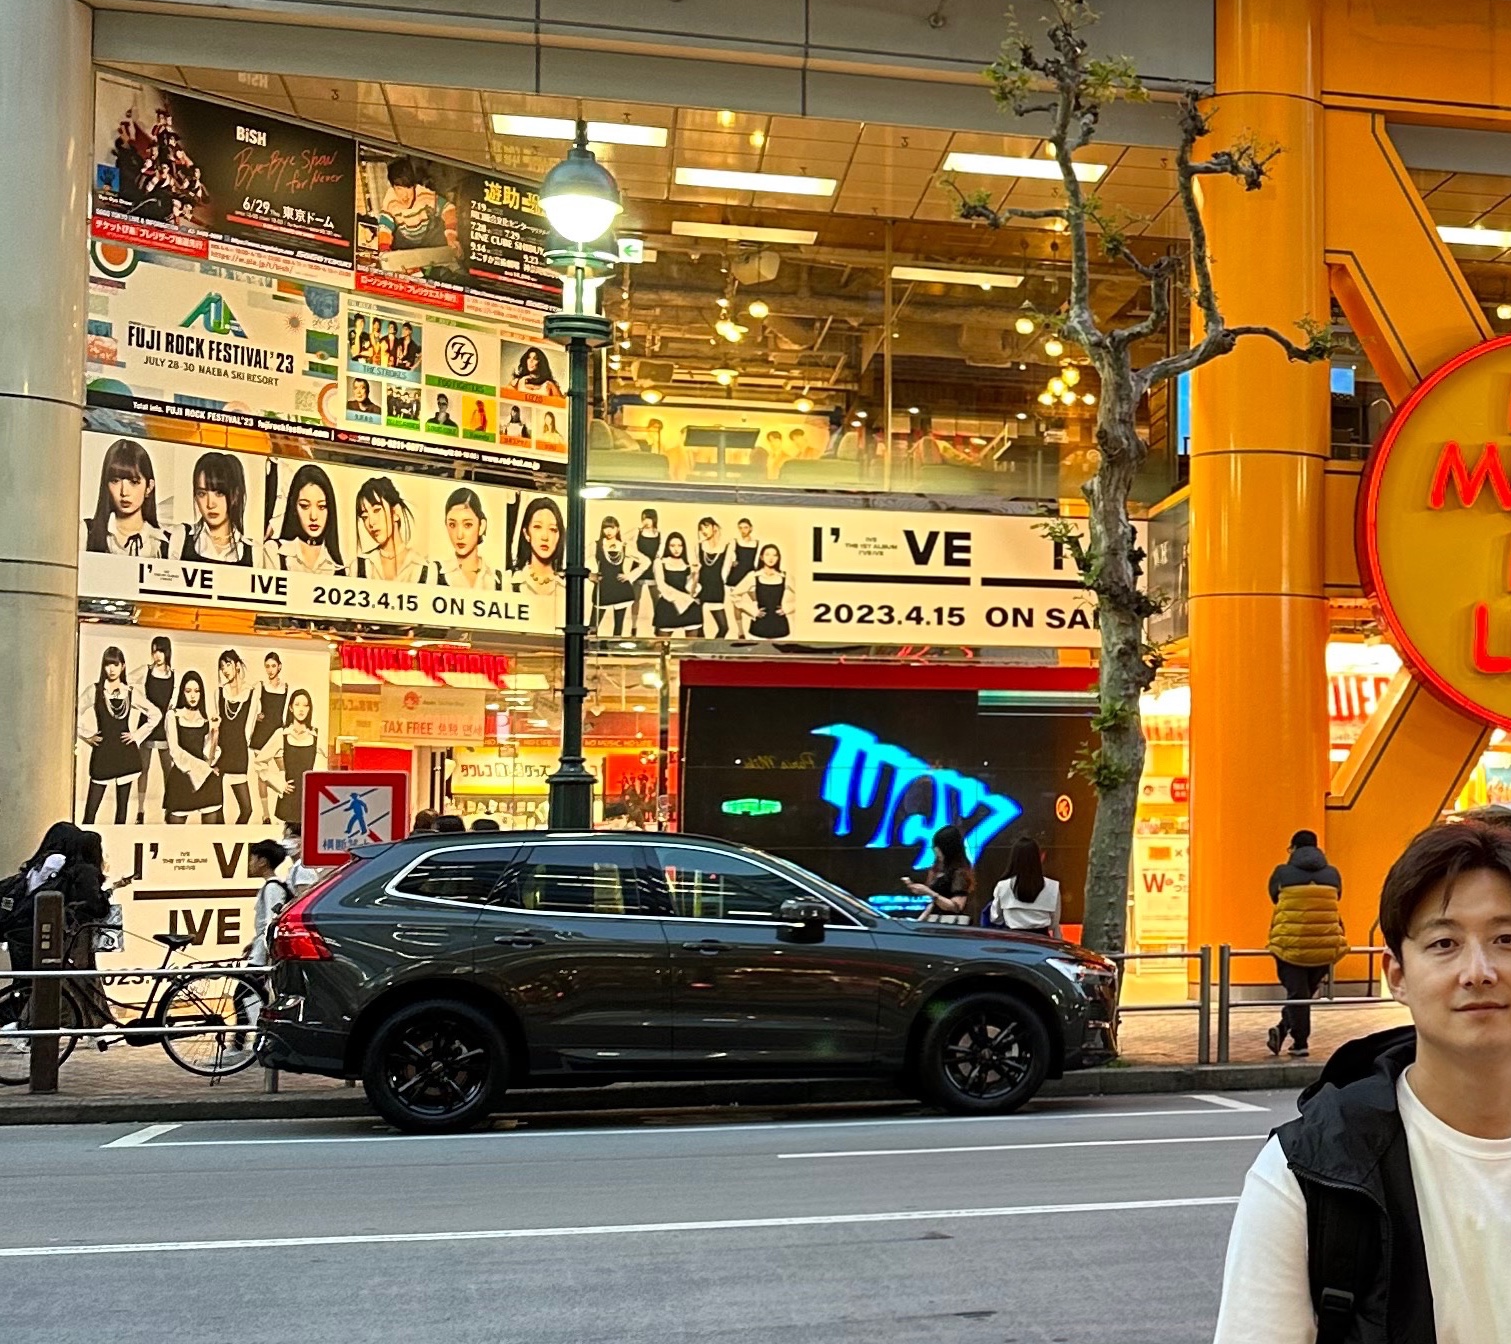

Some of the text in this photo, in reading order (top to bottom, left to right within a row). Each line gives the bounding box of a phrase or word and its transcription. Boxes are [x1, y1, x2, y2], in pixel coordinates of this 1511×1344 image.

[236, 125, 267, 147] BiSH
[242, 196, 271, 215] 6/29
[282, 206, 335, 229] 東京ドーム
[514, 243, 545, 257] SHIBUY
[127, 325, 161, 352] FUJI
[165, 332, 207, 360] ROCK
[143, 355, 166, 368] JULY
[231, 369, 245, 381] SKI
[246, 372, 279, 387] RESORT
[165, 405, 183, 416] FUJI
[185, 408, 206, 419] ROCK
[250, 574, 288, 596] IVE
[312, 587, 530, 622] 2023.4.15 ON SALE
[813, 603, 966, 626] 2023.4.15
[985, 607, 1034, 628] ON
[382, 720, 403, 734] TAX
[406, 722, 434, 735] FREE
[169, 908, 241, 946] IVE
